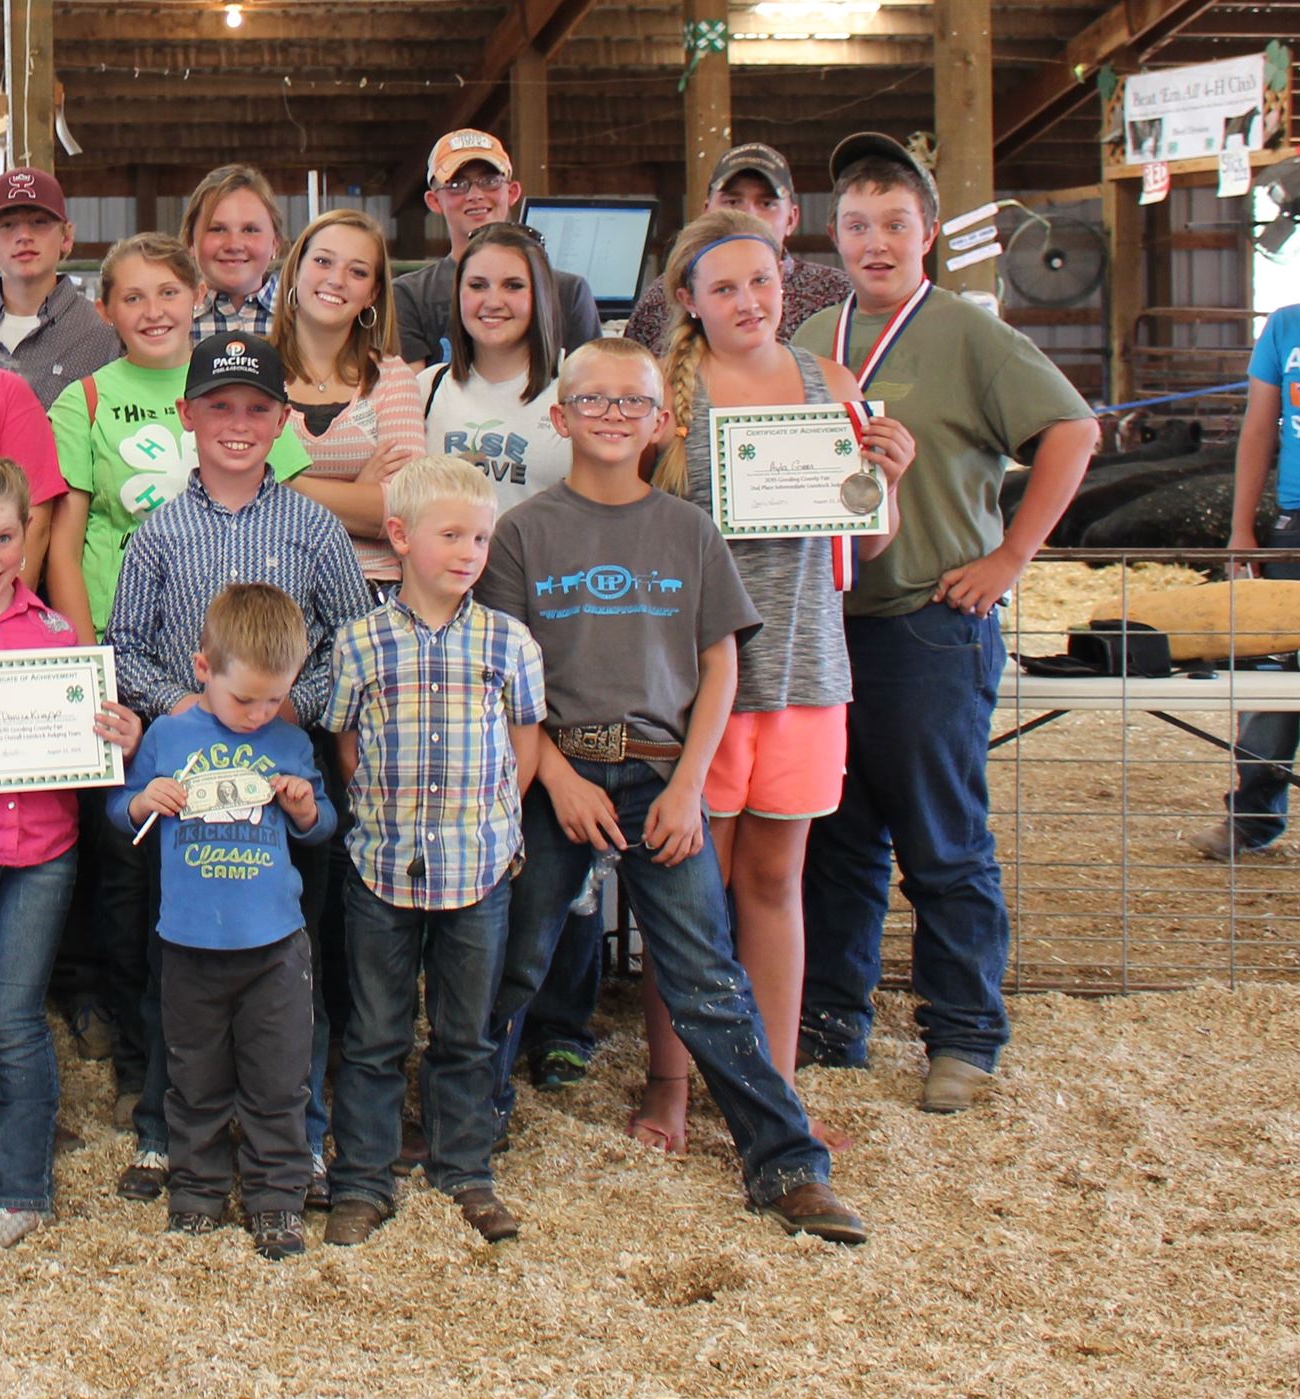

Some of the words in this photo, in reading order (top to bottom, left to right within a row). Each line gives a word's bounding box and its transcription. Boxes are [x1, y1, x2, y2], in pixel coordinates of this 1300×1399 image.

[213, 356, 260, 369] PACIFIC
[185, 843, 274, 867] Classic
[201, 865, 259, 880] CAMP
